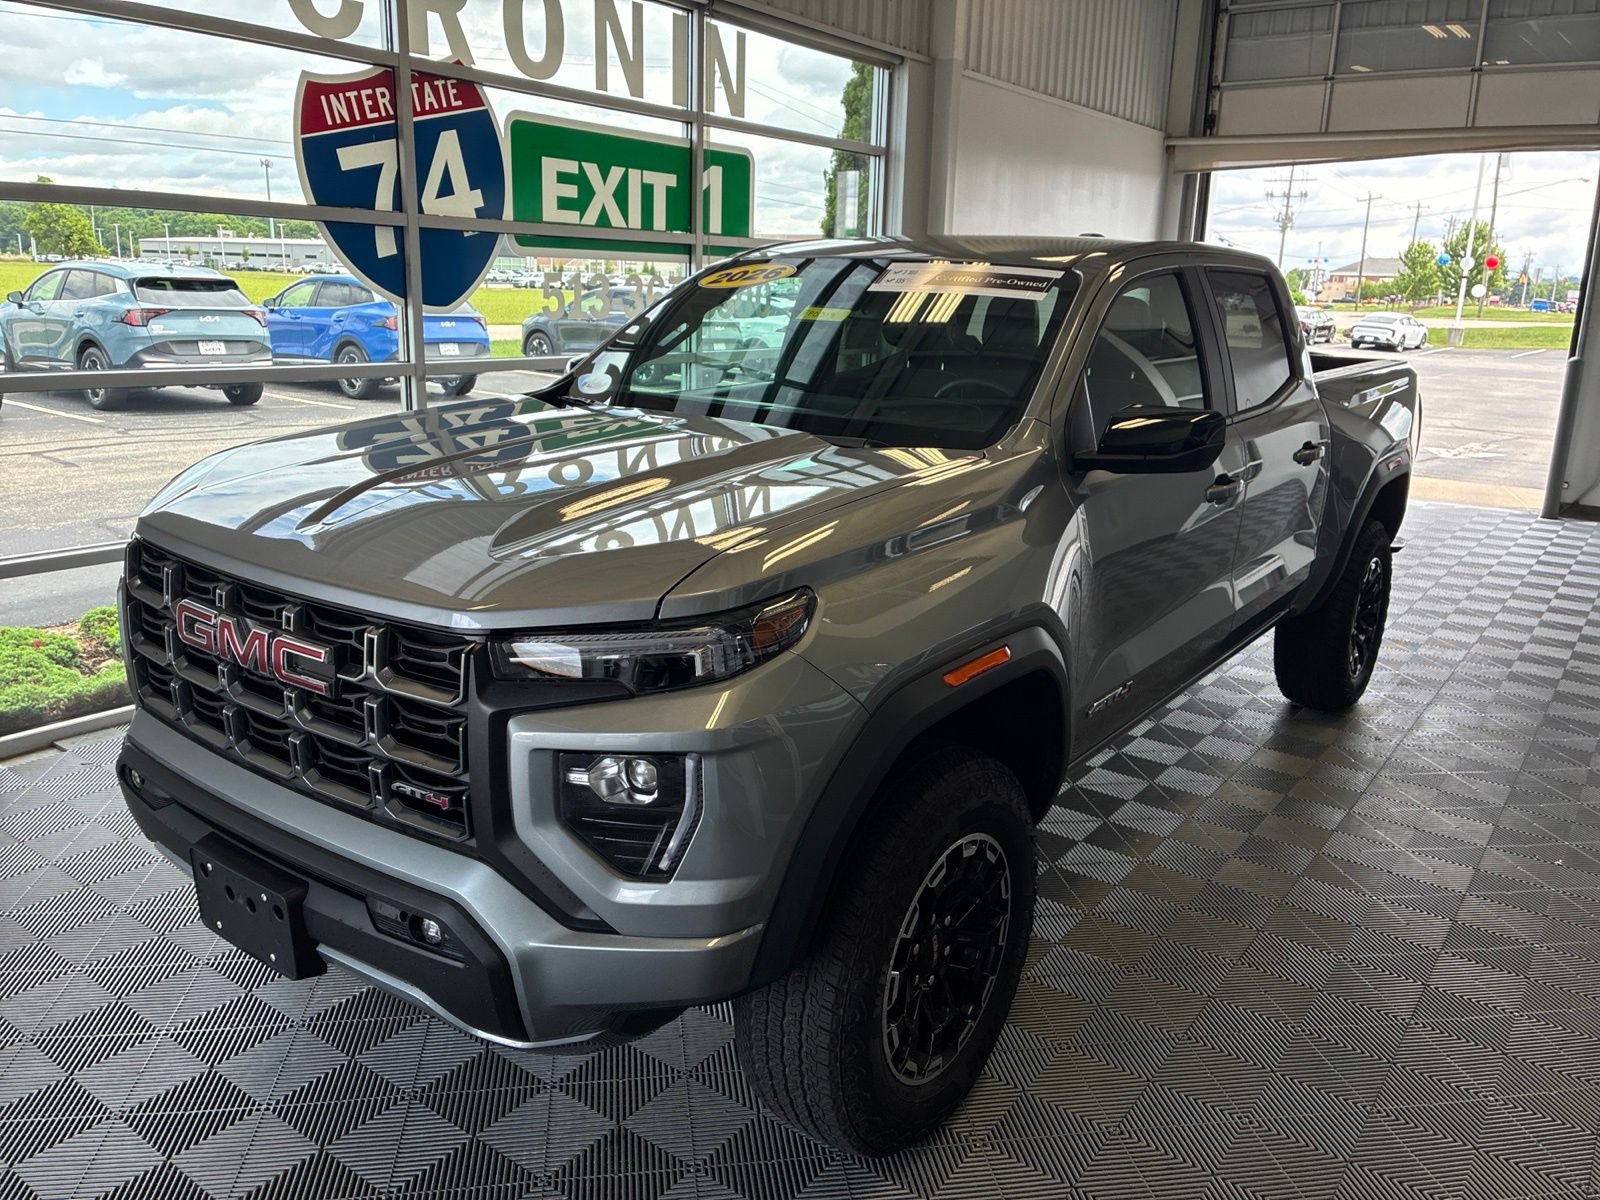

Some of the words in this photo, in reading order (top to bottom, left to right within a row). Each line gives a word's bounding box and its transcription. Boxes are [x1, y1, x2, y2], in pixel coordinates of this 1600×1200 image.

[320, 73, 463, 125] INTERTATE
[336, 129, 484, 258] 74
[541, 156, 677, 231] EXIT
[703, 165, 722, 234] 1
[541, 271, 690, 321] 513-36
[705, 267, 787, 286] 2026
[984, 277, 1048, 288] Pre-Owned
[176, 599, 331, 696] GMC
[391, 782, 449, 811] AT4
